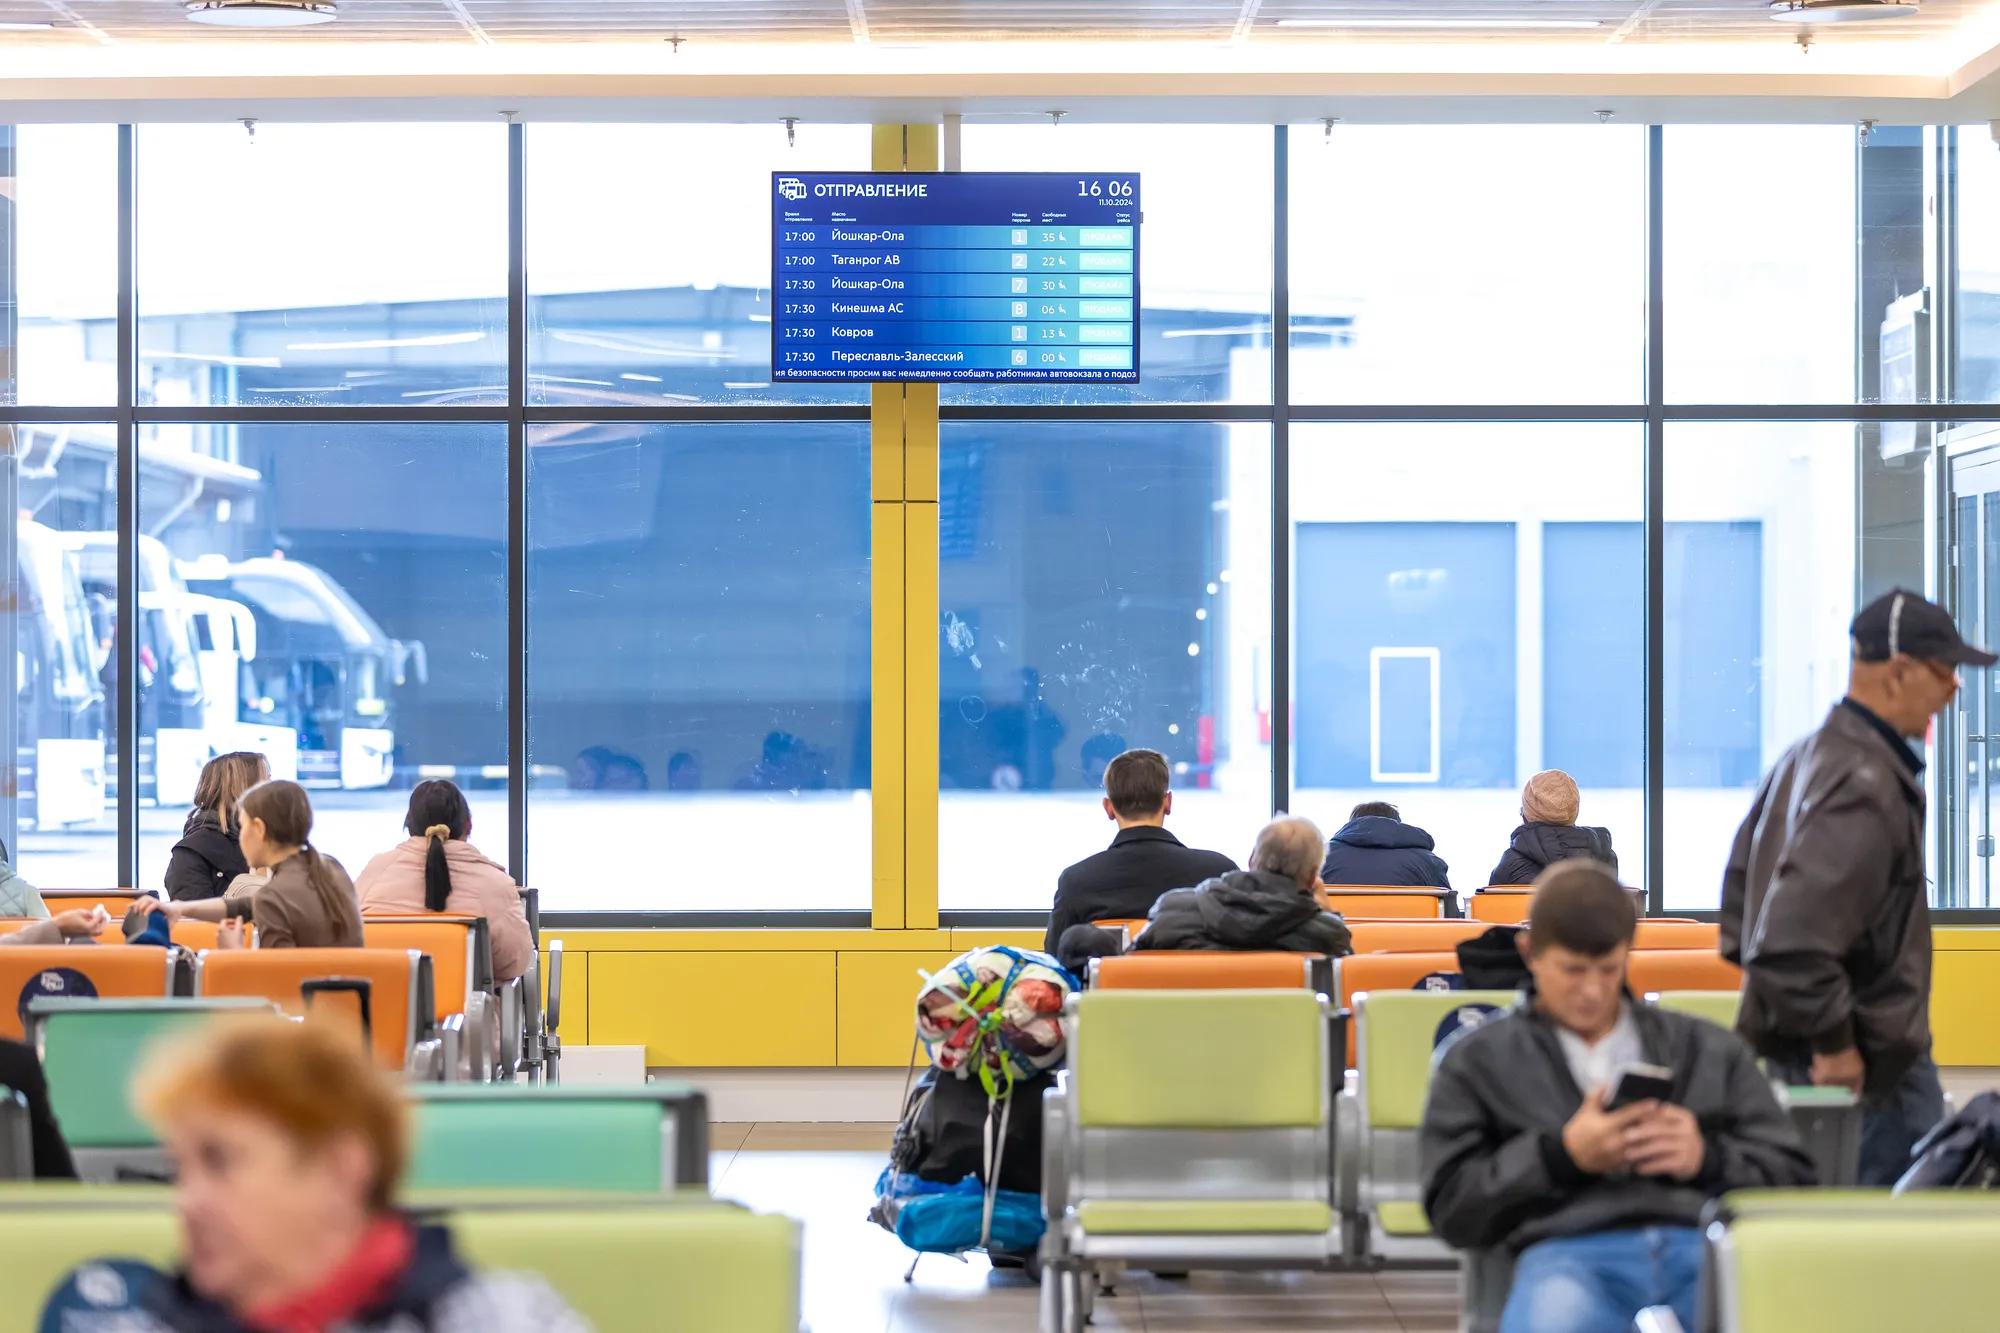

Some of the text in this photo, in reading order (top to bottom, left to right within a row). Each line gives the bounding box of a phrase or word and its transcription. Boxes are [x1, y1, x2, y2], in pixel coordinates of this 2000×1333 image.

[814, 184, 927, 197] ОТПРАВЛЕНИЕ
[1078, 180, 1132, 196] 16 06
[785, 232, 815, 241] 17:00
[832, 228, 904, 242] Йошкар-Ола
[1042, 233, 1055, 242] 35
[785, 256, 815, 265] 17:00
[832, 255, 881, 267] Таганрог
[884, 255, 900, 264] АВ
[1042, 257, 1055, 266] 22
[785, 280, 815, 289] 17:30
[832, 277, 904, 291] Йошкар-Ола
[1042, 282, 1055, 290] 30
[785, 304, 815, 313] 17:30
[832, 303, 884, 313] Кинешма
[888, 303, 904, 313] АС
[1042, 306, 1055, 314] 06
[785, 328, 815, 337] 17:30
[832, 327, 873, 339] Ковров
[1042, 329, 1055, 338] 13
[785, 352, 815, 361] 17:30
[832, 350, 964, 364] Переславль-Залесский
[1042, 354, 1055, 362] 00
[953, 370, 994, 378] сообщать
[996, 370, 1047, 378] работникам
